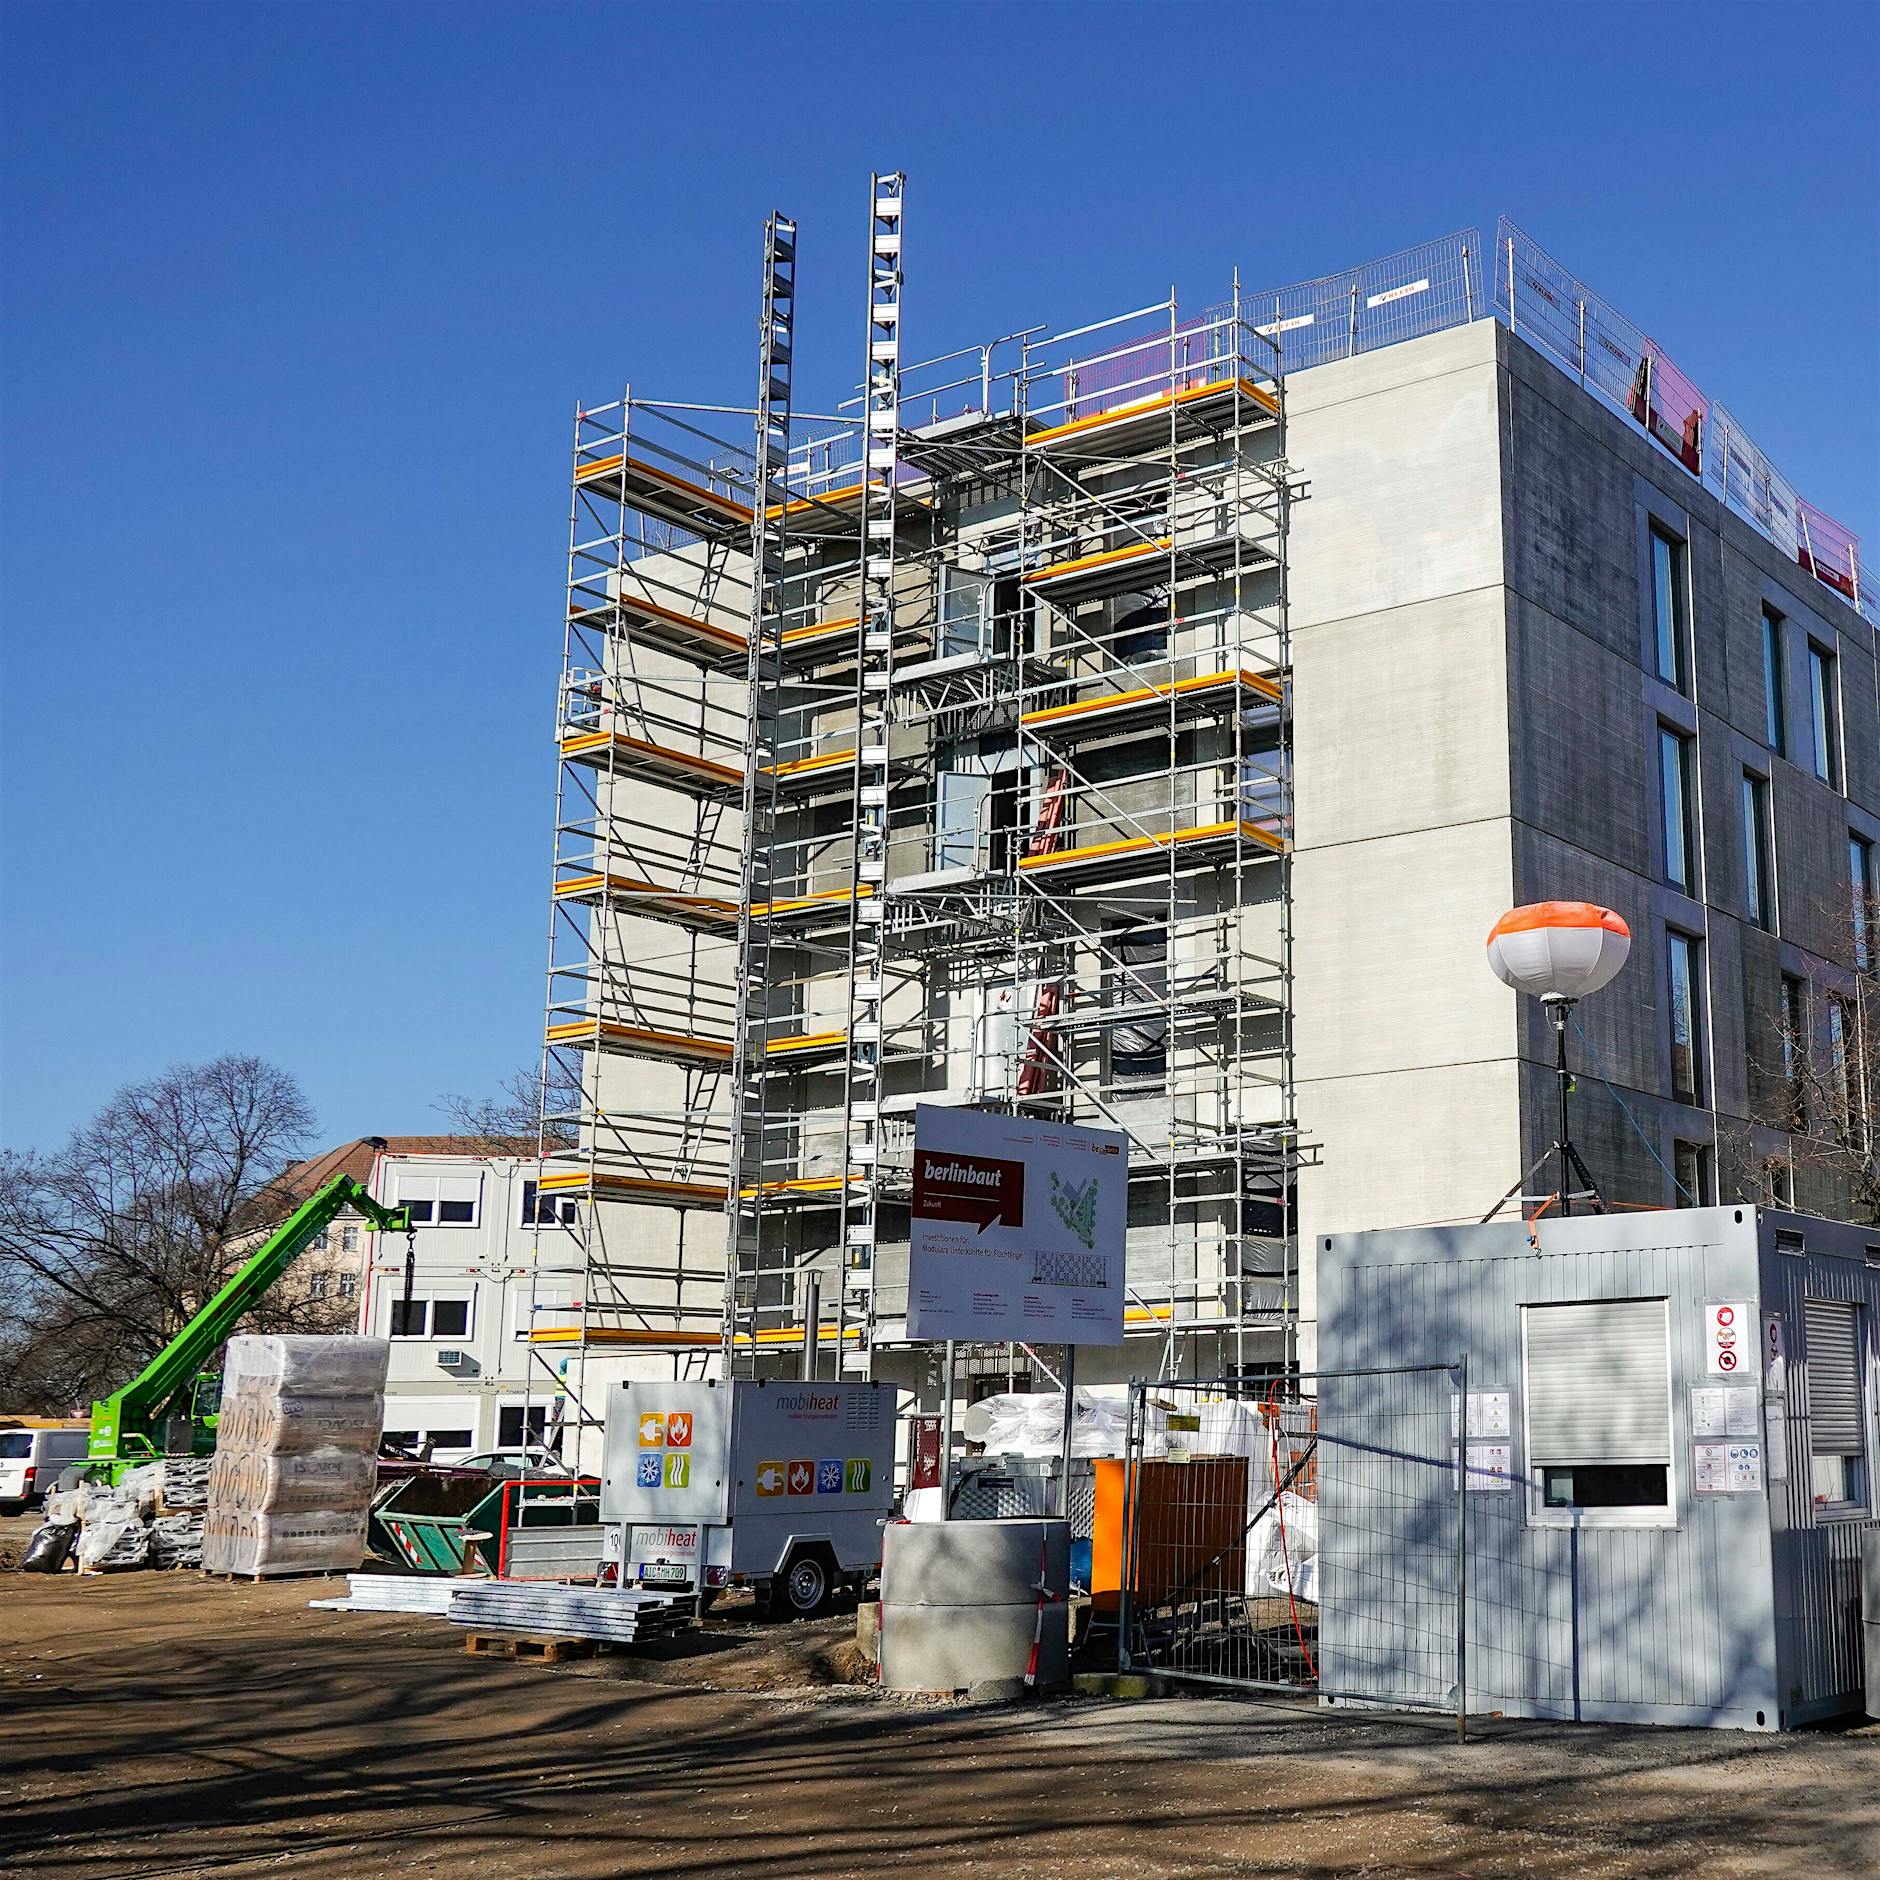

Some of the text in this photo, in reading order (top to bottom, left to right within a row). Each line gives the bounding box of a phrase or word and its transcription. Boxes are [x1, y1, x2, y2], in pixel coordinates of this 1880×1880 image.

[924, 1159, 1002, 1187] berlinbaut
[922, 1232, 959, 1244] Investitionen
[922, 1243, 949, 1254] Modulare
[775, 1392, 840, 1410] mobiheat
[636, 1528, 697, 1547] mobiheat
[644, 1566, 657, 1578] AIC
[671, 1568, 684, 1579] 709
